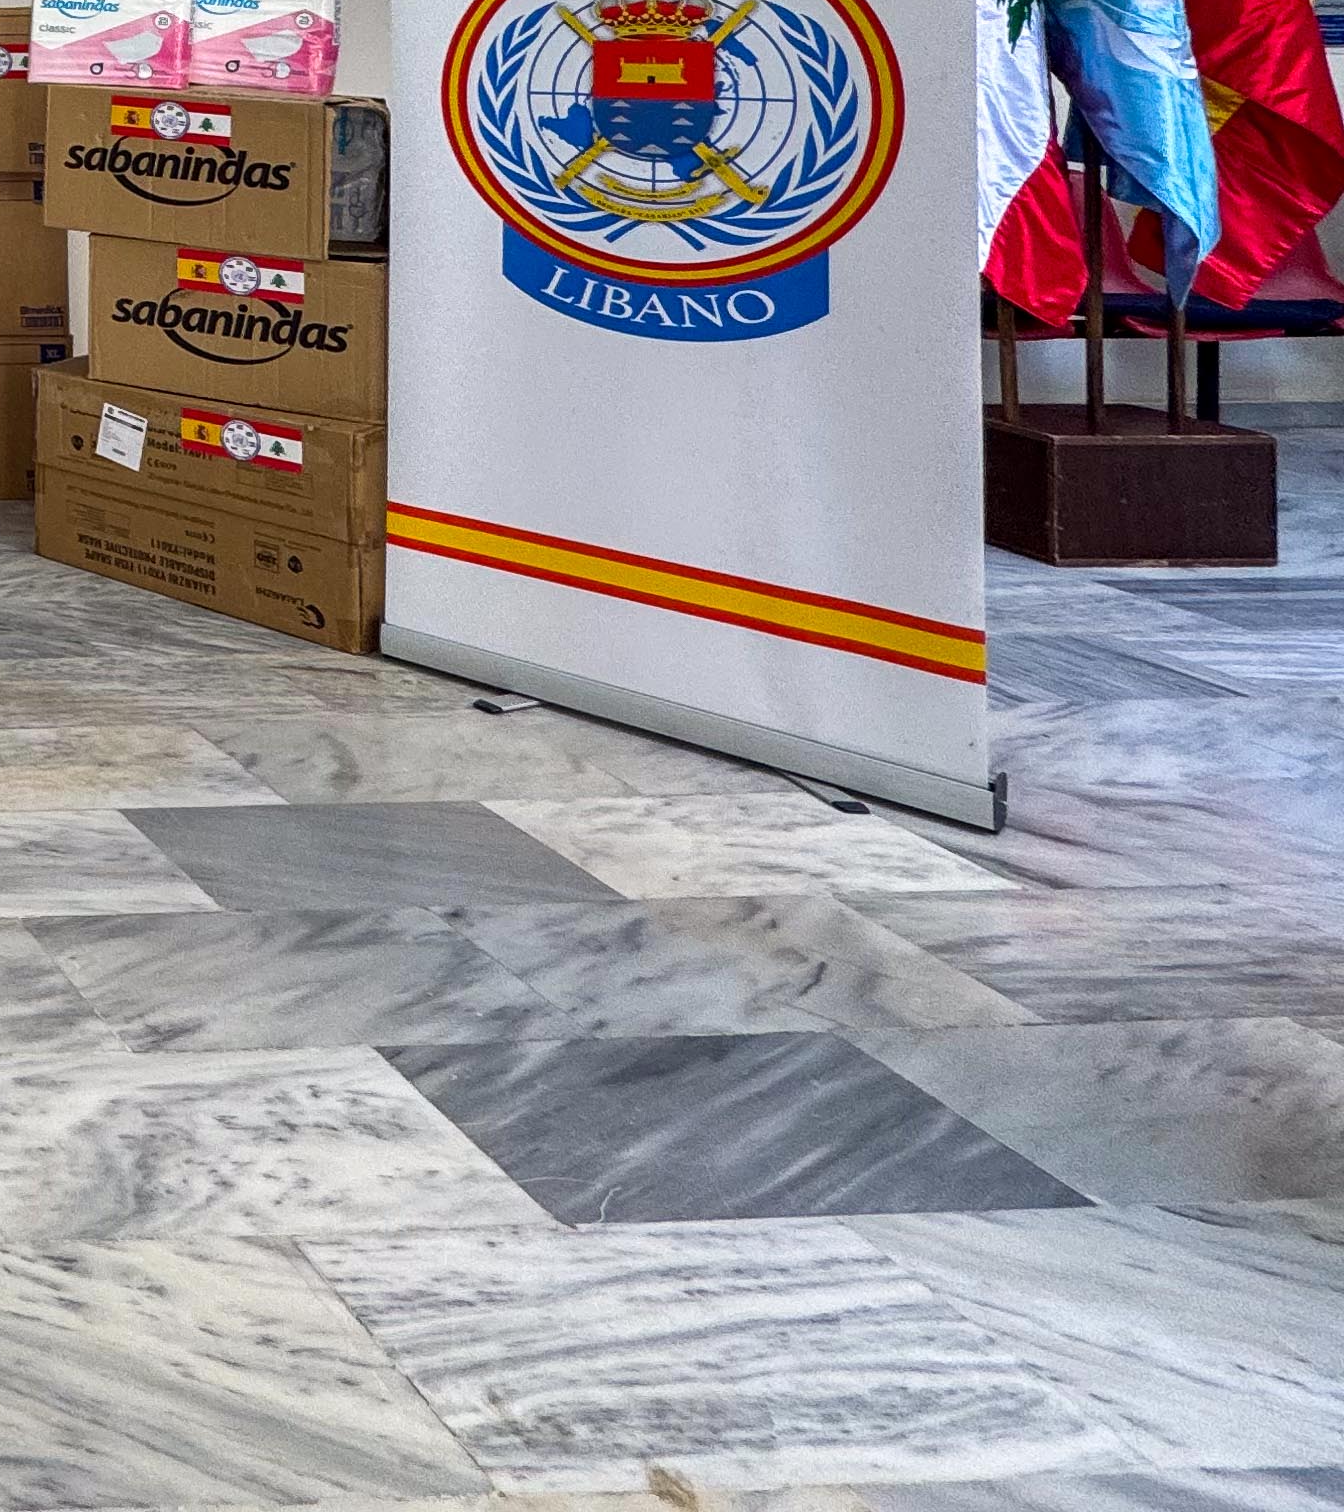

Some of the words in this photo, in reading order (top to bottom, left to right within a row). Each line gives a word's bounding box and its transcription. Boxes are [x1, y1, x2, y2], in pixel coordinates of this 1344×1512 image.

[38, 23, 76, 34] classic
[64, 145, 292, 190] sabanindas
[539, 264, 776, 329] LIBANO
[112, 297, 348, 354] sabanindas
